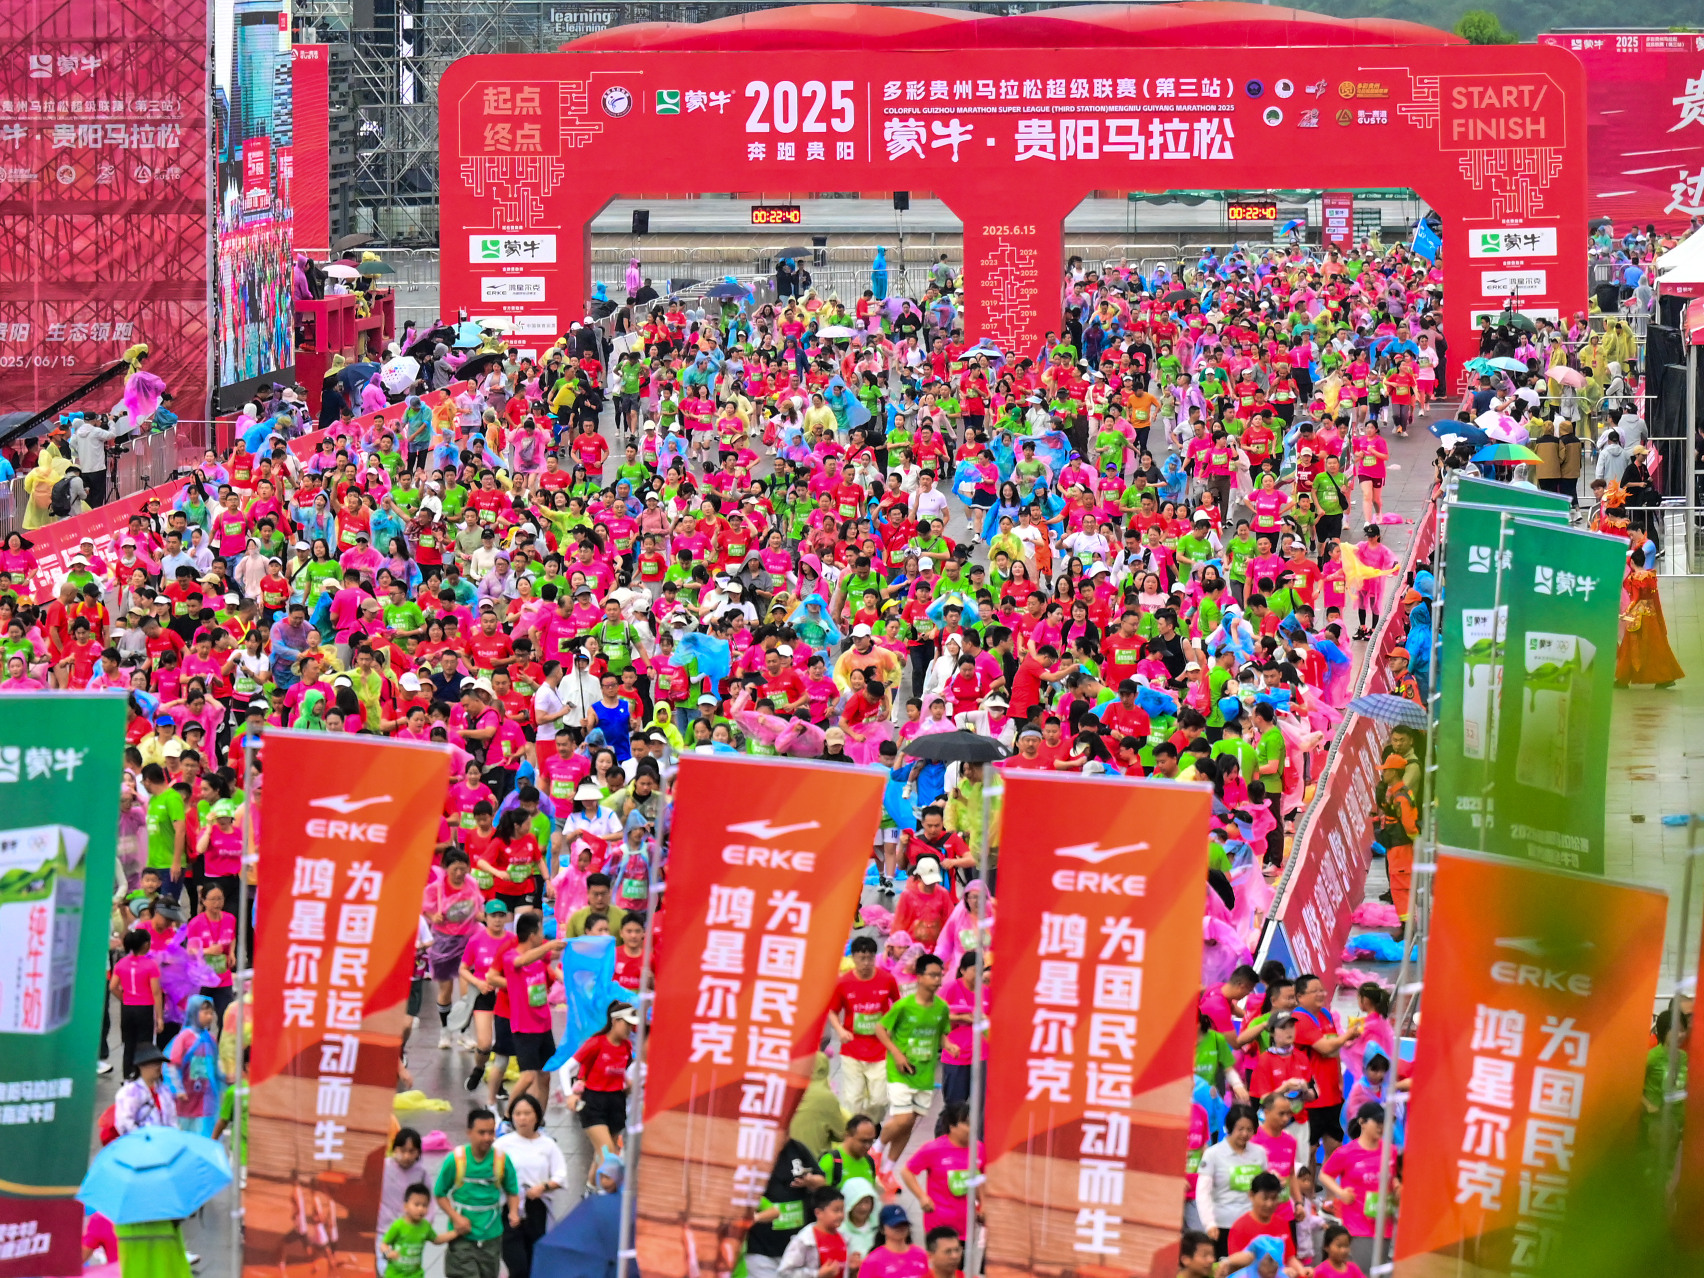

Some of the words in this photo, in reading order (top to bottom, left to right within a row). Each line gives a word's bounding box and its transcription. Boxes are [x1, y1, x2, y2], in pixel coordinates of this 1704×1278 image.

[551, 8, 611, 24] learning
[1616, 36, 1639, 48] 2025
[57, 55, 102, 78] 蒙牛
[483, 86, 542, 115] 起点
[684, 90, 732, 115] 蒙牛
[884, 78, 1234, 101] 多彩贵州马拉松超级联赛（第三站）
[1452, 84, 1548, 112] START/
[745, 80, 855, 134] 2025
[1051, 105, 1075, 113] (THIRD
[1142, 104, 1175, 112] GUIYANG
[1175, 104, 1217, 112] MARATHON
[1217, 104, 1235, 112] 2025
[483, 123, 543, 152] 终点
[1453, 117, 1546, 141] FINISH
[747, 141, 854, 161] 奔跑贵阳
[753, 210, 800, 223] 00:22:40
[1229, 207, 1276, 220] 00:22:40
[982, 225, 1036, 236] 2025.6.15
[1504, 233, 1541, 251] 蒙牛
[504, 240, 541, 258] 蒙牛
[45, 322, 134, 342] 生态领跑
[1556, 570, 1597, 602] 蒙牛
[25, 746, 83, 782] 蒙牛
[306, 819, 388, 844] ERKE
[721, 844, 816, 872] ERKE
[1052, 870, 1146, 896] ERKE
[283, 856, 335, 1028] 鸿星尔克
[689, 885, 755, 1065] 鸿星尔克
[1491, 961, 1592, 997] ERKE
[314, 862, 383, 1161] 为国民运动而生
[1025, 911, 1087, 1102] 鸿星尔克
[731, 890, 812, 1207] 为国民运动而生
[1074, 916, 1145, 1255] 为国民运动而生
[1454, 1003, 1526, 1211] 鸿星尔克
